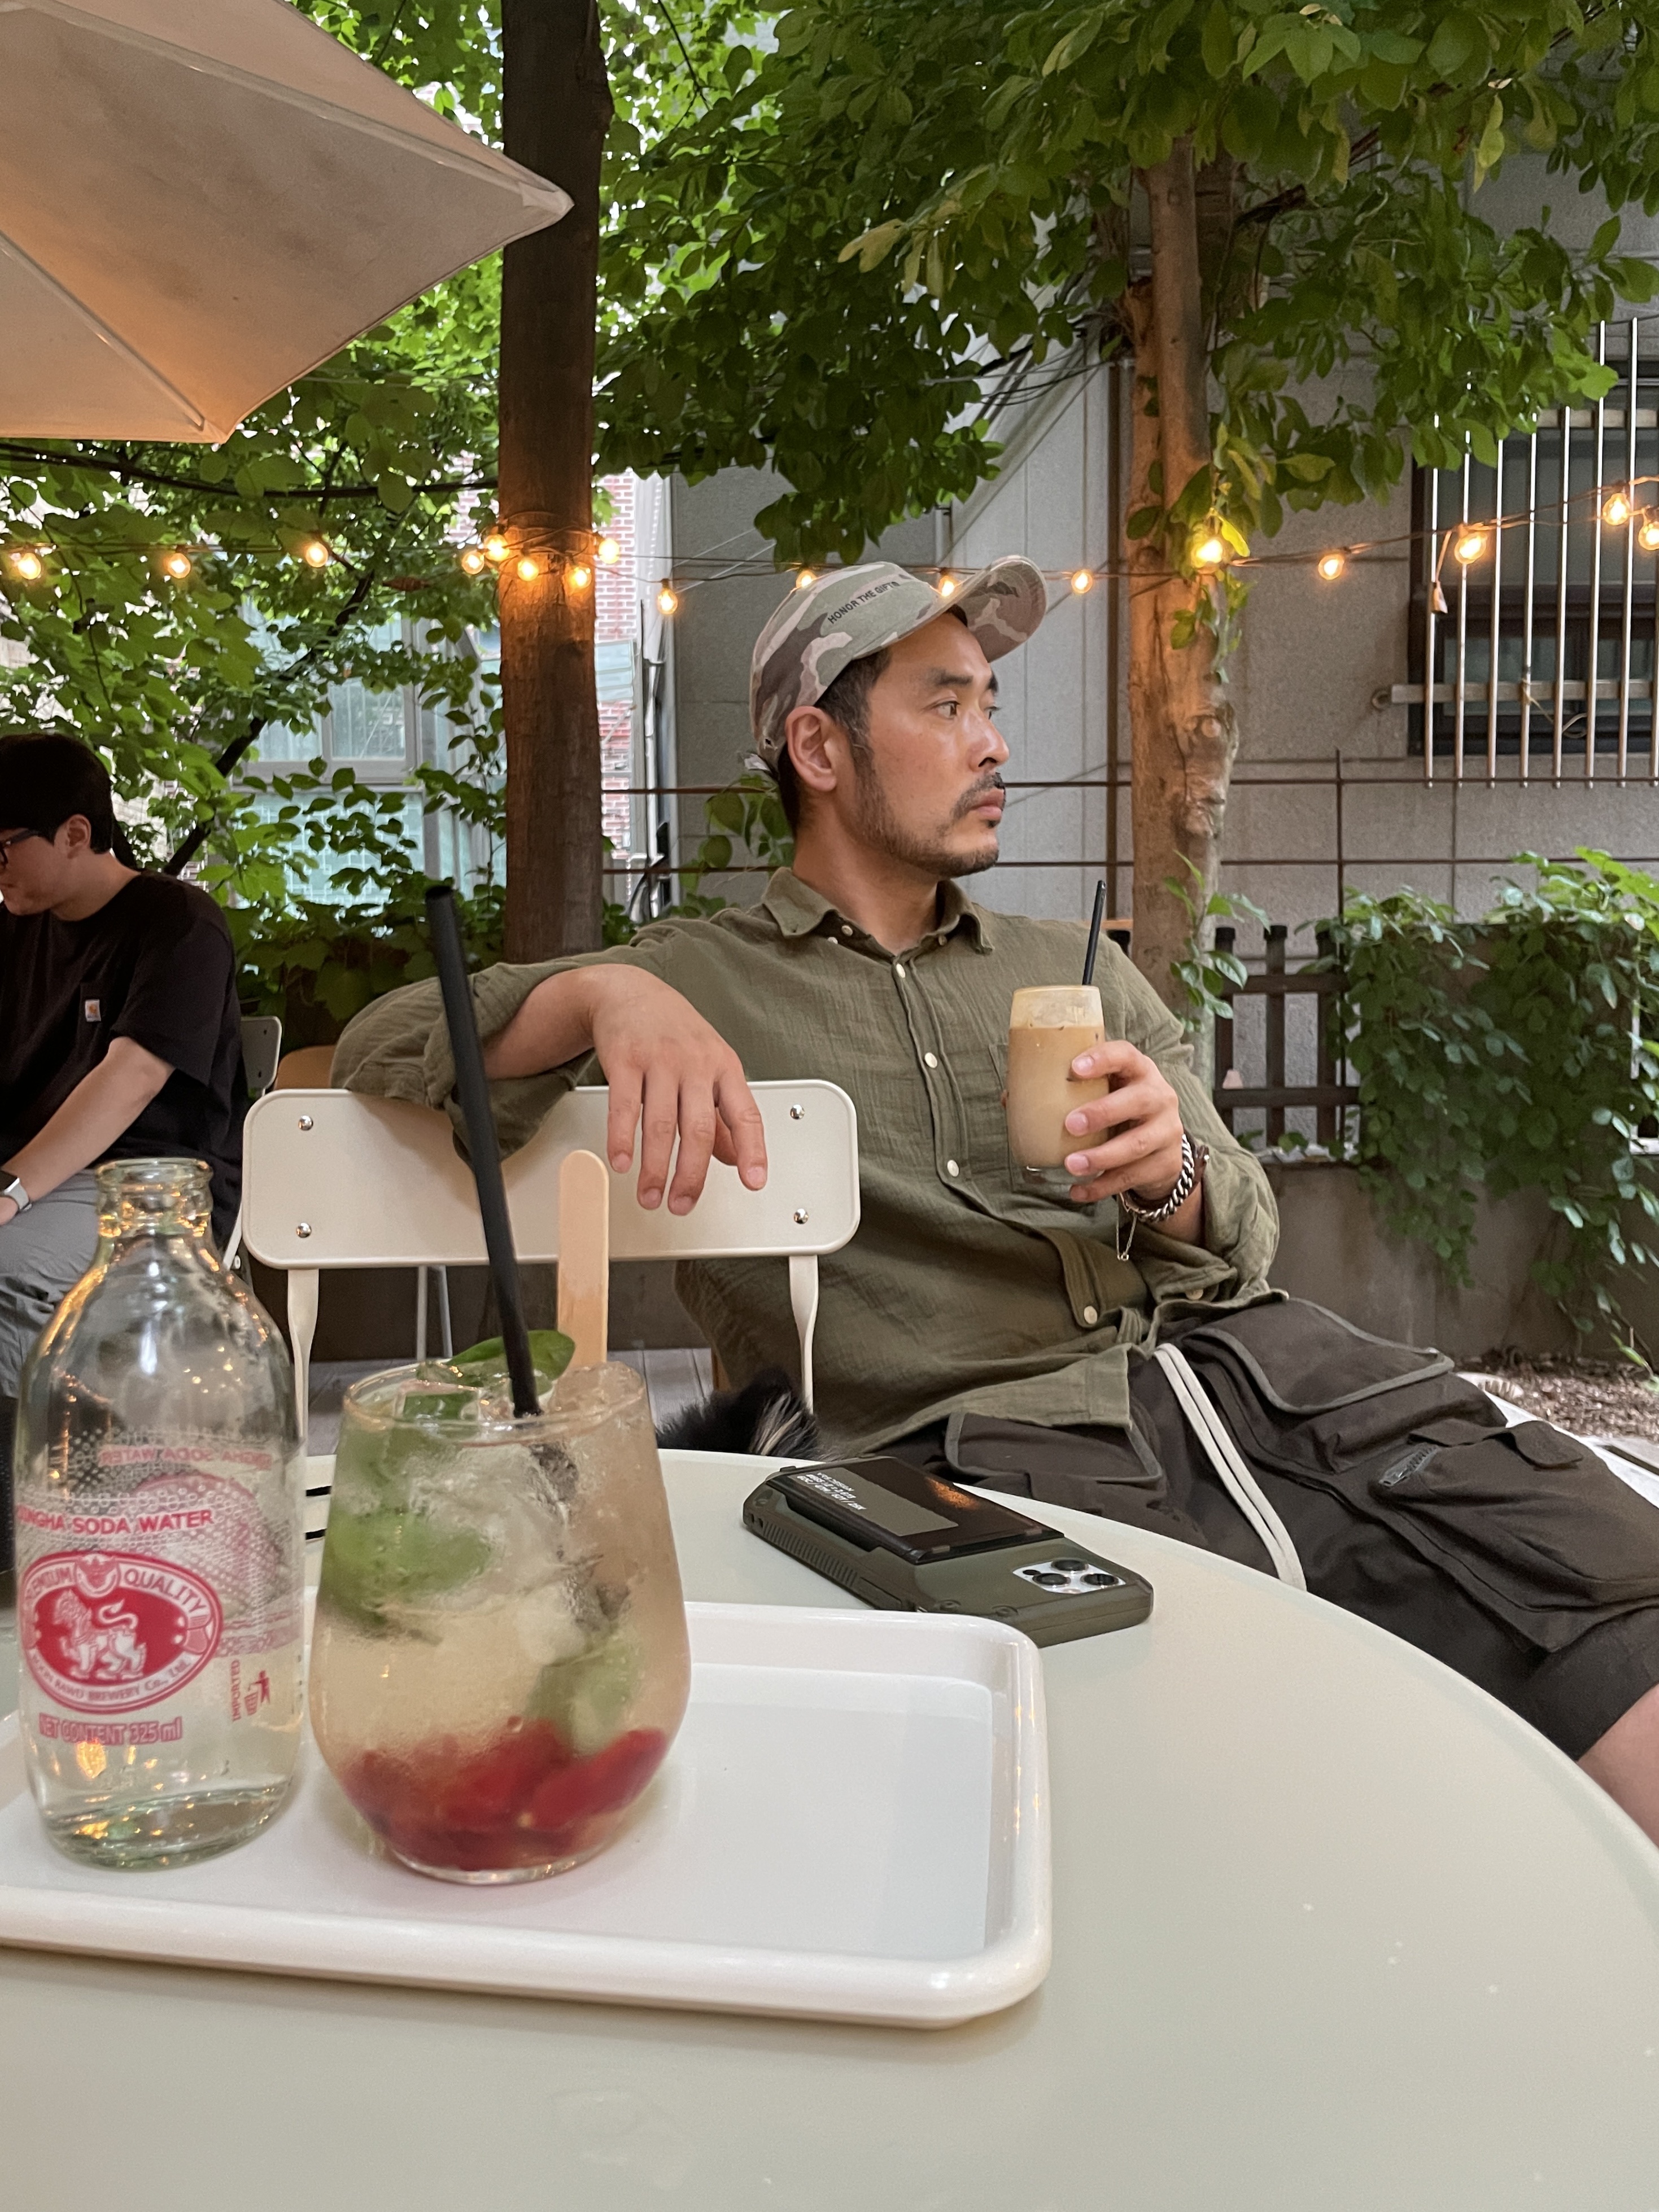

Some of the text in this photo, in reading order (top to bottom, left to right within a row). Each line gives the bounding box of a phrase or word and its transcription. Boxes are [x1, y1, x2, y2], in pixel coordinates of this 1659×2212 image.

[827, 582, 893, 624] HONOR THE GIFT
[72, 1515, 132, 1535] SODA
[138, 1509, 214, 1533] WATER
[25, 1567, 207, 1614] REMIUM QUALITY
[230, 1659, 242, 1723] IMPORTED
[39, 1712, 182, 1746] NET CONTENT 325 ml
